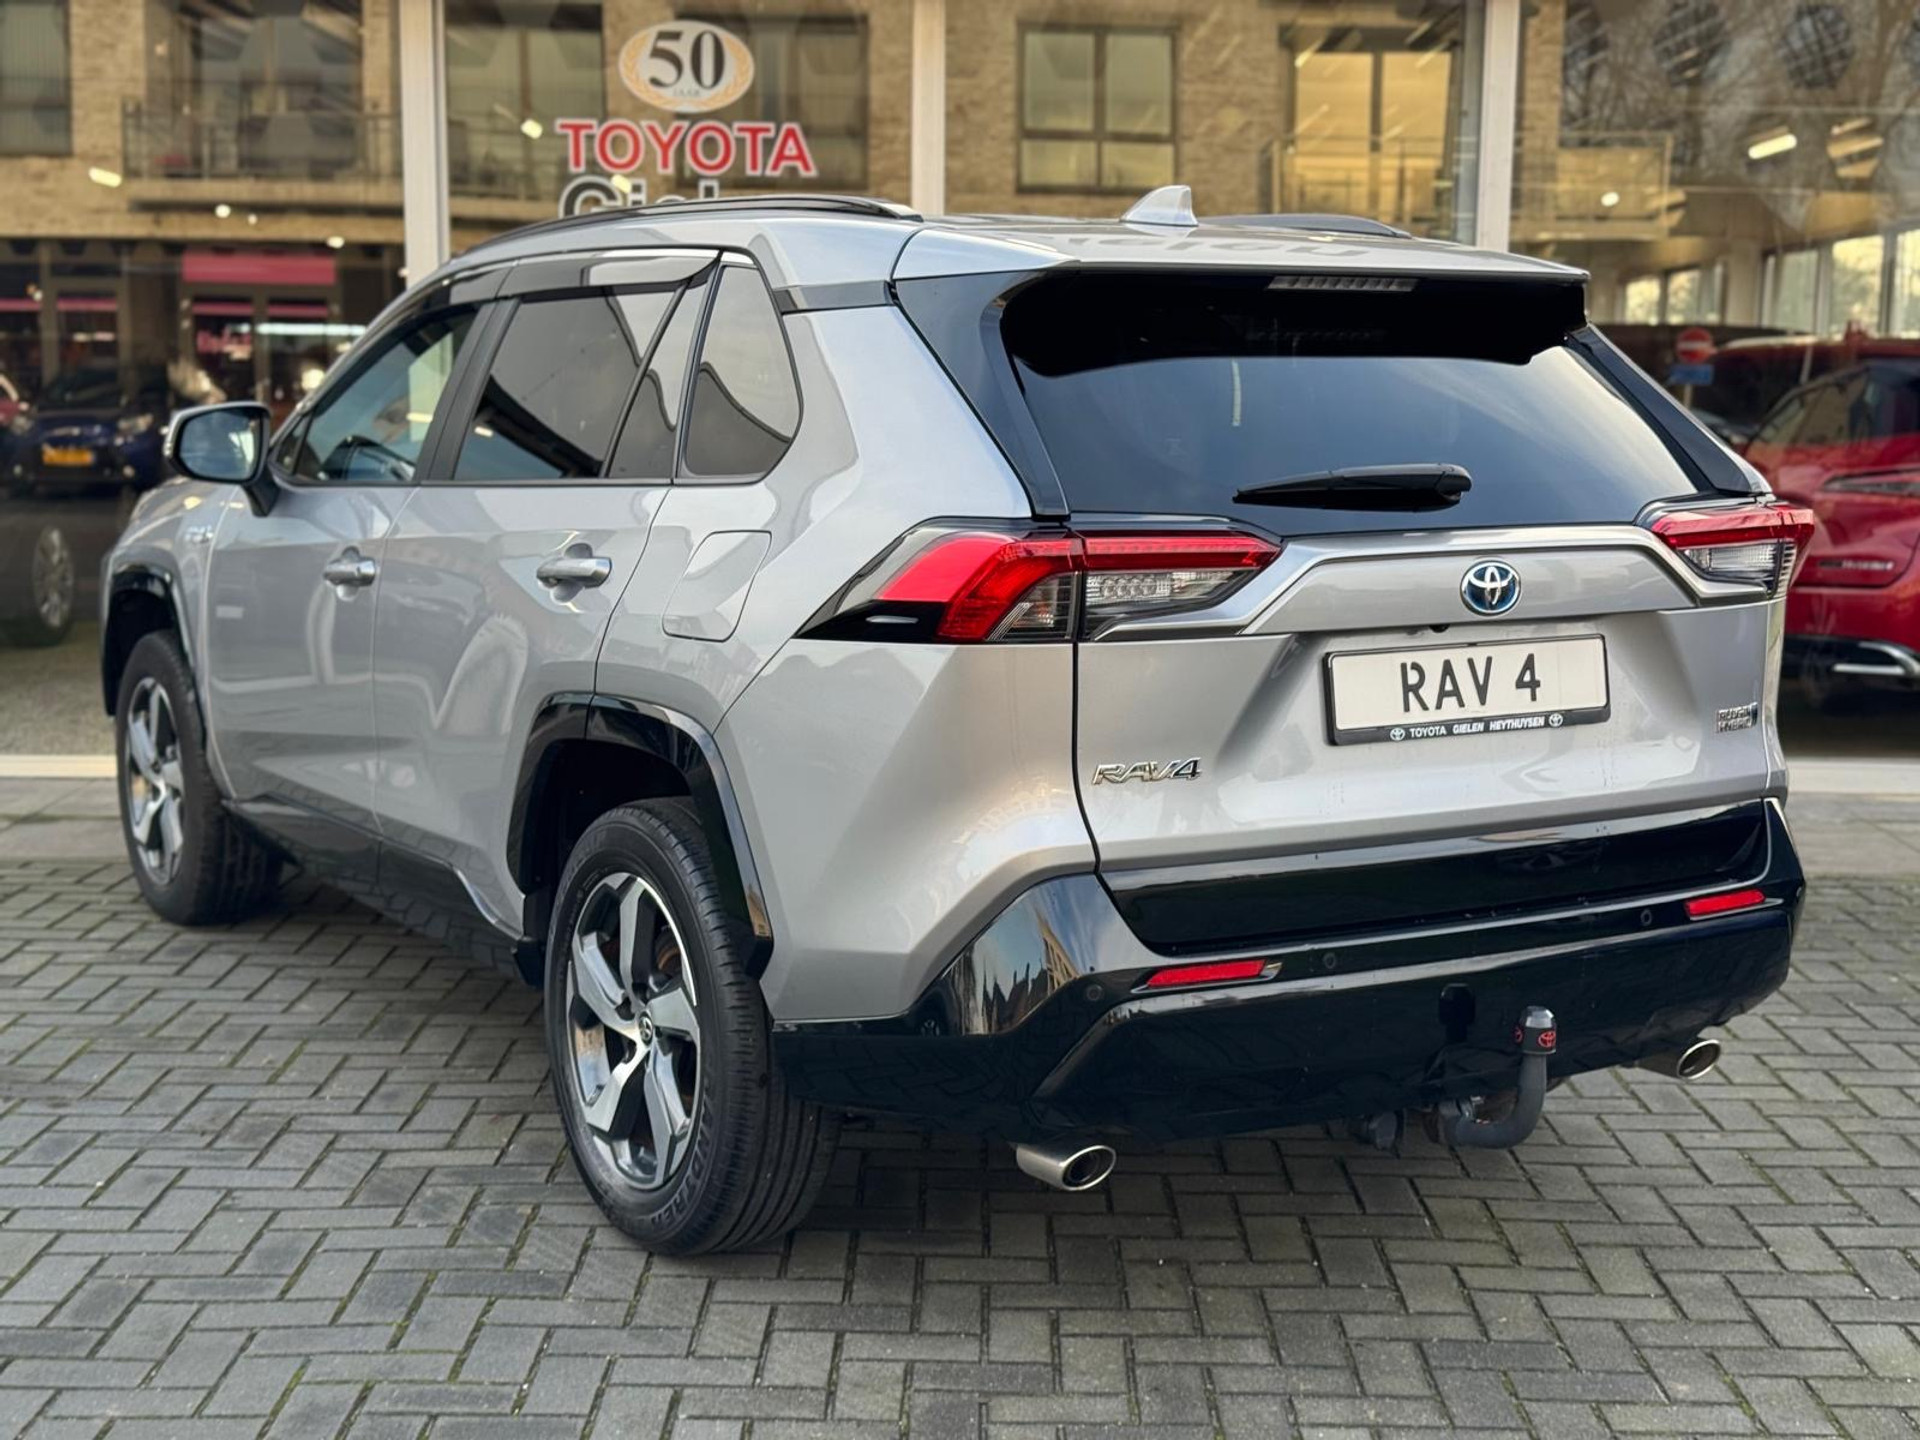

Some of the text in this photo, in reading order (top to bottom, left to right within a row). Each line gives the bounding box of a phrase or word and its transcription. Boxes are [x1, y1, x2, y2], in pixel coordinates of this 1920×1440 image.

[649, 30, 725, 88] 50
[556, 120, 816, 176] TOYOTA
[1400, 653, 1541, 712] RAV 4
[1409, 716, 1545, 738] TOYOTA GIELEN HEYTHUYSEN
[1093, 757, 1202, 785] RAV4
